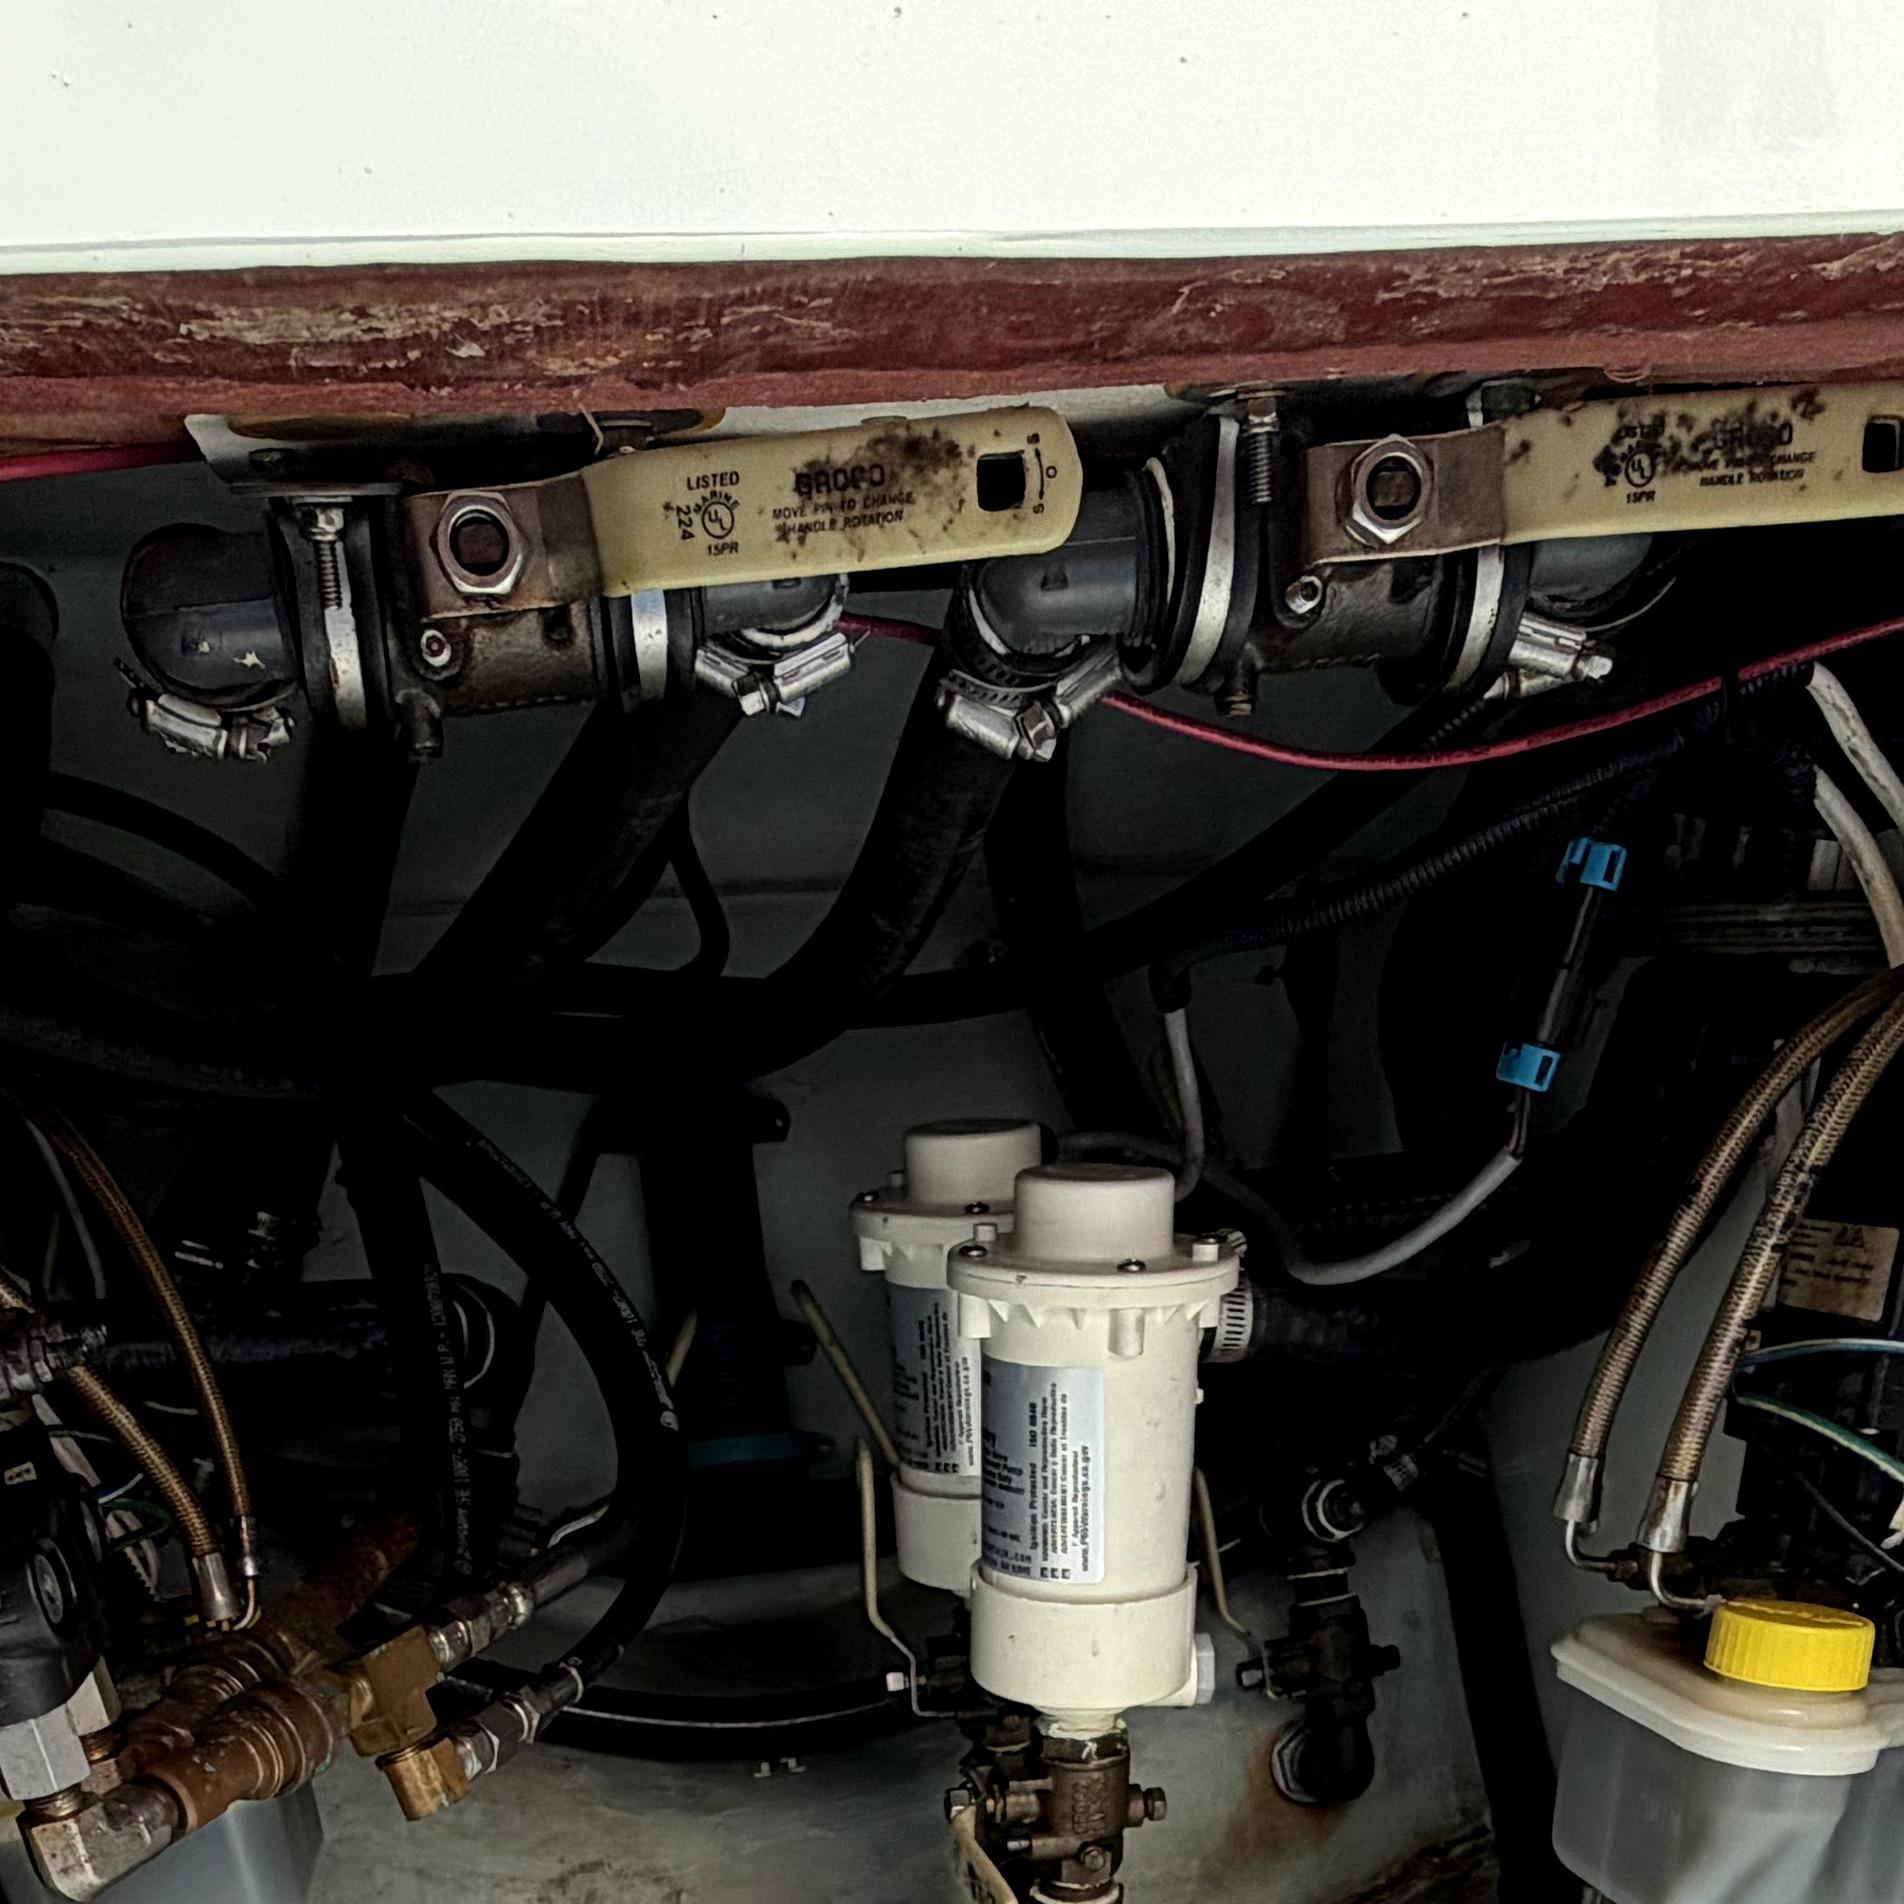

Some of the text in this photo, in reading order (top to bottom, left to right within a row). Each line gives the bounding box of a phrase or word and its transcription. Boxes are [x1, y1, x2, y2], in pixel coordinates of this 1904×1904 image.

[686, 471, 740, 491] LISTED
[772, 506, 807, 521] MOVE
[863, 490, 915, 509] CHANGE
[676, 505, 695, 541] 224
[788, 509, 904, 534] HANDLE ROTATION
[707, 541, 739, 557] 15PR
